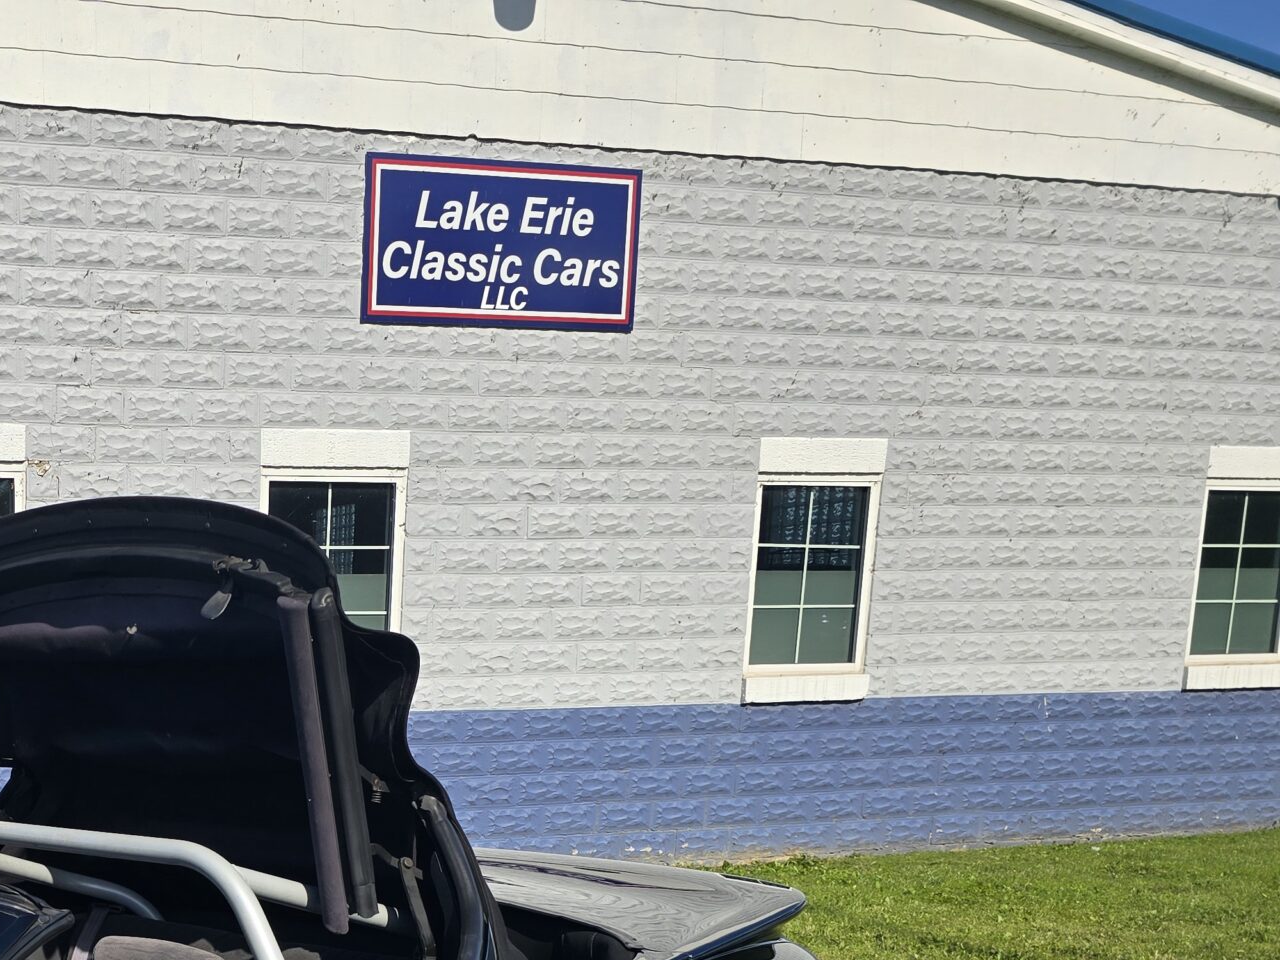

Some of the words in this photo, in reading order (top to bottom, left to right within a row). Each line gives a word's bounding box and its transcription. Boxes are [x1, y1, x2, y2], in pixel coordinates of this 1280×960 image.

[414, 190, 510, 233] Lake
[519, 196, 595, 237] Erie
[382, 239, 522, 284] Classic
[533, 248, 620, 289] Cars
[480, 285, 529, 311] LLC
